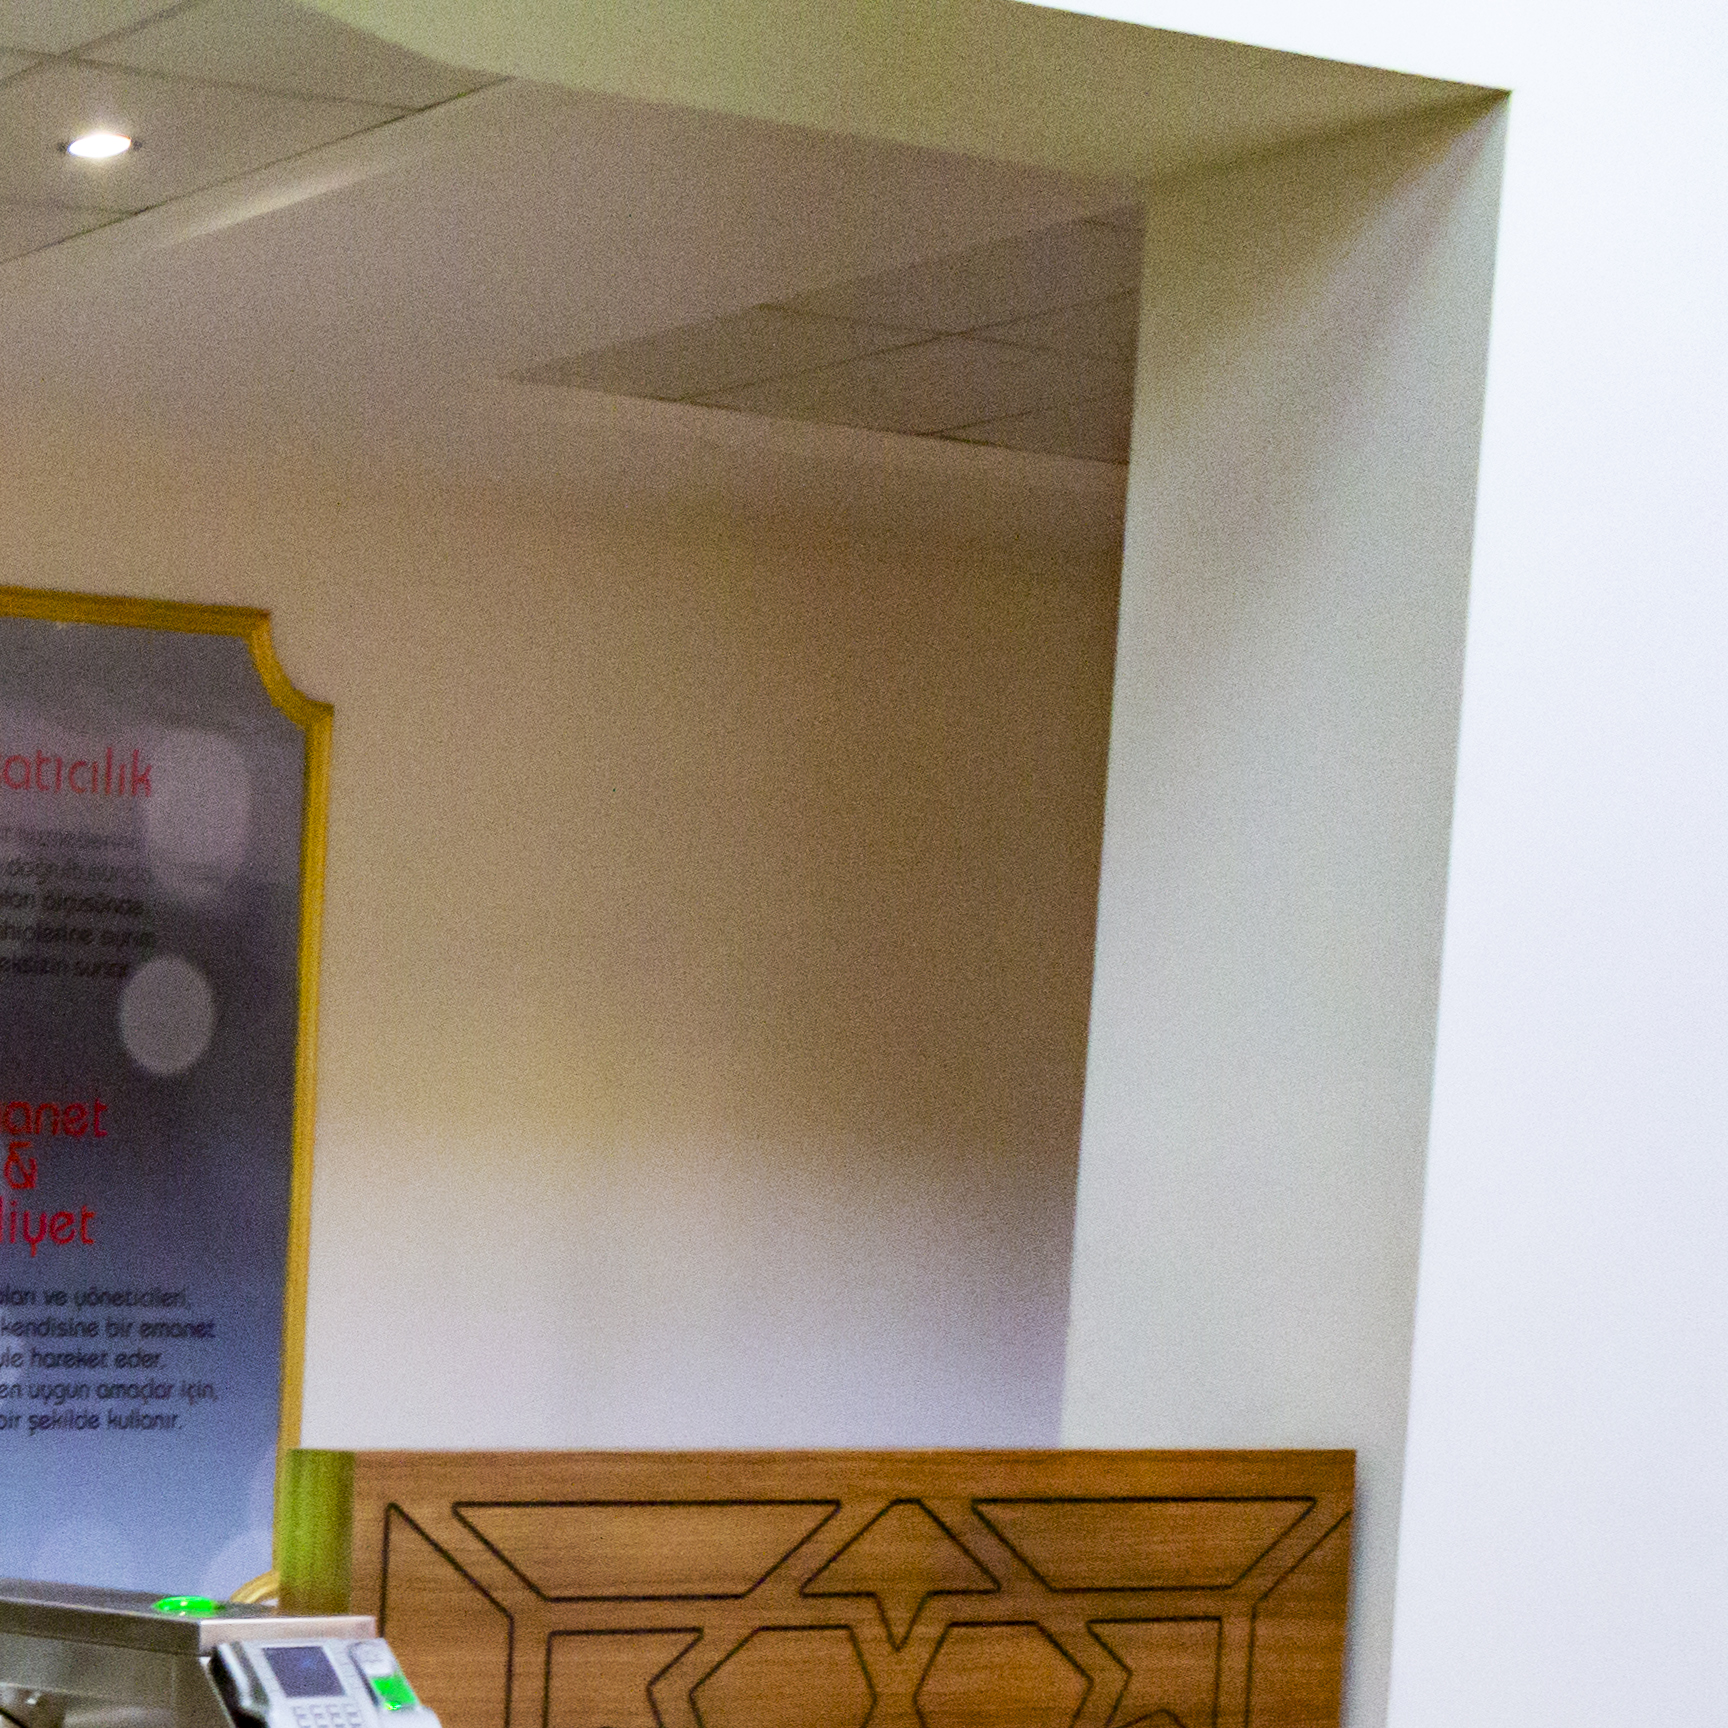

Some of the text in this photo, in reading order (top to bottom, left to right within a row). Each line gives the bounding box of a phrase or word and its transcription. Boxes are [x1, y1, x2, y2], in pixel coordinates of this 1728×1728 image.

[2, 1140, 38, 1190] &
[43, 1288, 67, 1307] ve
[104, 1317, 134, 1339] bir
[138, 1320, 217, 1339] emanet
[29, 1347, 109, 1369] hareket
[26, 1382, 91, 1406] uygun
[27, 1409, 100, 1437] şekilde
